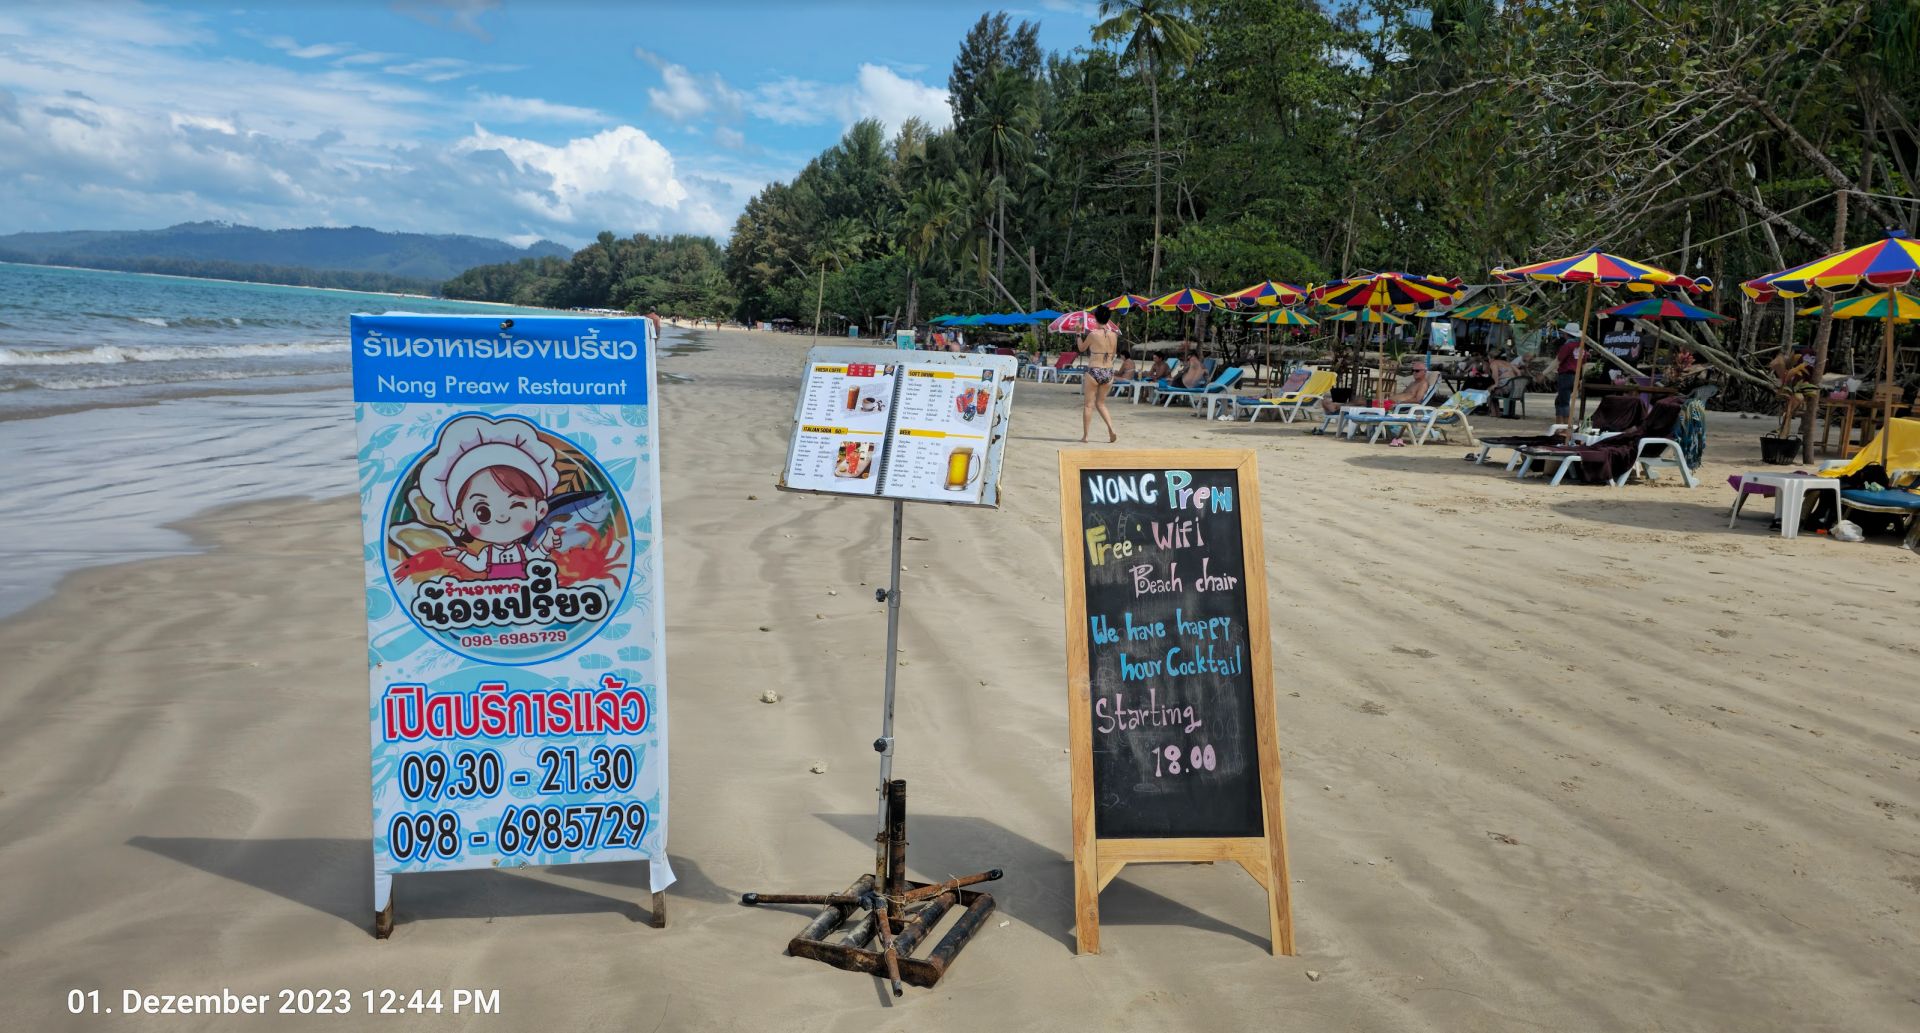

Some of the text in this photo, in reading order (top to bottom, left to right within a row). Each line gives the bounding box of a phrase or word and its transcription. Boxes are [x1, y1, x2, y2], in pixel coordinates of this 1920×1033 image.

[363, 328, 638, 360] ร้านอาหารน้องเปรี้ยว
[378, 375, 627, 397] Nong Preaw Restaurant
[1088, 473, 1159, 504] NONG
[418, 565, 602, 625] น้องเปรี้ยว
[445, 582, 520, 597] ร้านอาหาร
[1129, 557, 1238, 598] Beach chair
[461, 630, 567, 648] 098-6985729
[1091, 608, 1230, 644] We have happy
[1120, 644, 1242, 681] hour Cocktail
[386, 677, 646, 739] เปิดบริการแล้ว
[1096, 688, 1202, 733] Starting
[403, 751, 500, 800] 09.30
[541, 748, 633, 792] 21.30
[1152, 744, 1216, 777] 18.00
[393, 813, 457, 859] 098
[500, 804, 645, 853] 6985729
